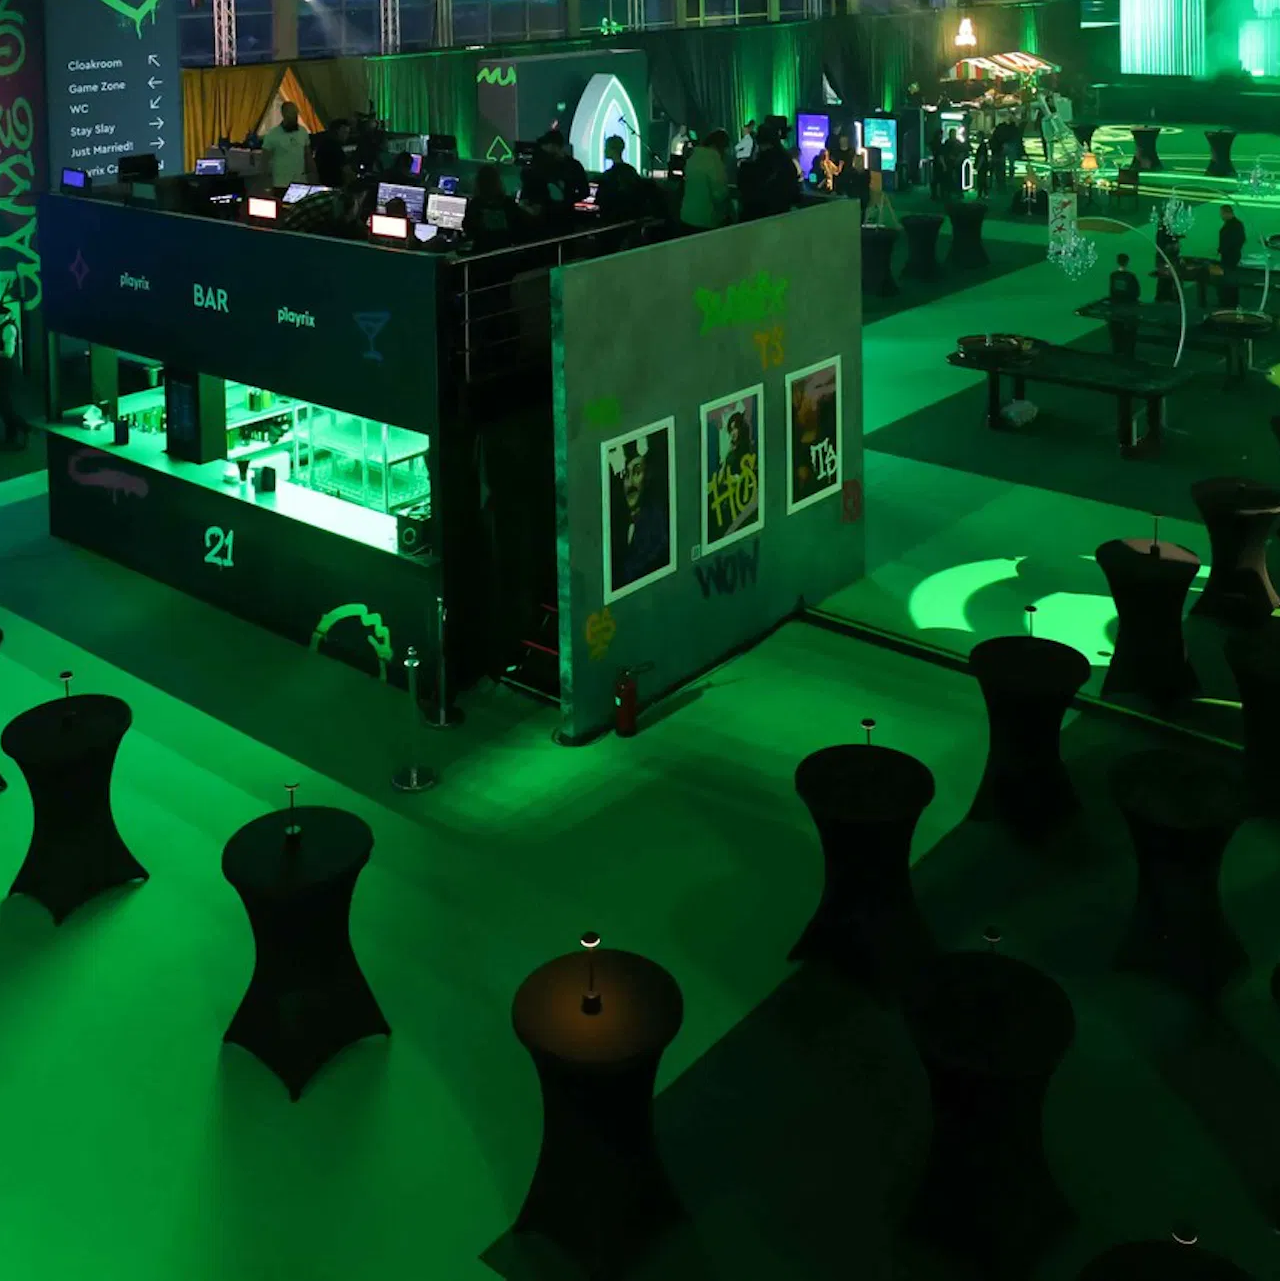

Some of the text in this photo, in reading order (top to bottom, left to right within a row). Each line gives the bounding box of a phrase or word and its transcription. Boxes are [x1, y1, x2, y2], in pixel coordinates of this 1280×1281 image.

[67, 58, 123, 71] Cloakroom
[68, 81, 126, 94] Game Zone
[69, 104, 89, 114] WC
[70, 123, 116, 138] Stay Slay
[71, 141, 134, 158] Just Married!
[120, 272, 316, 328] playrix BAR playrix
[204, 525, 235, 567] 21
